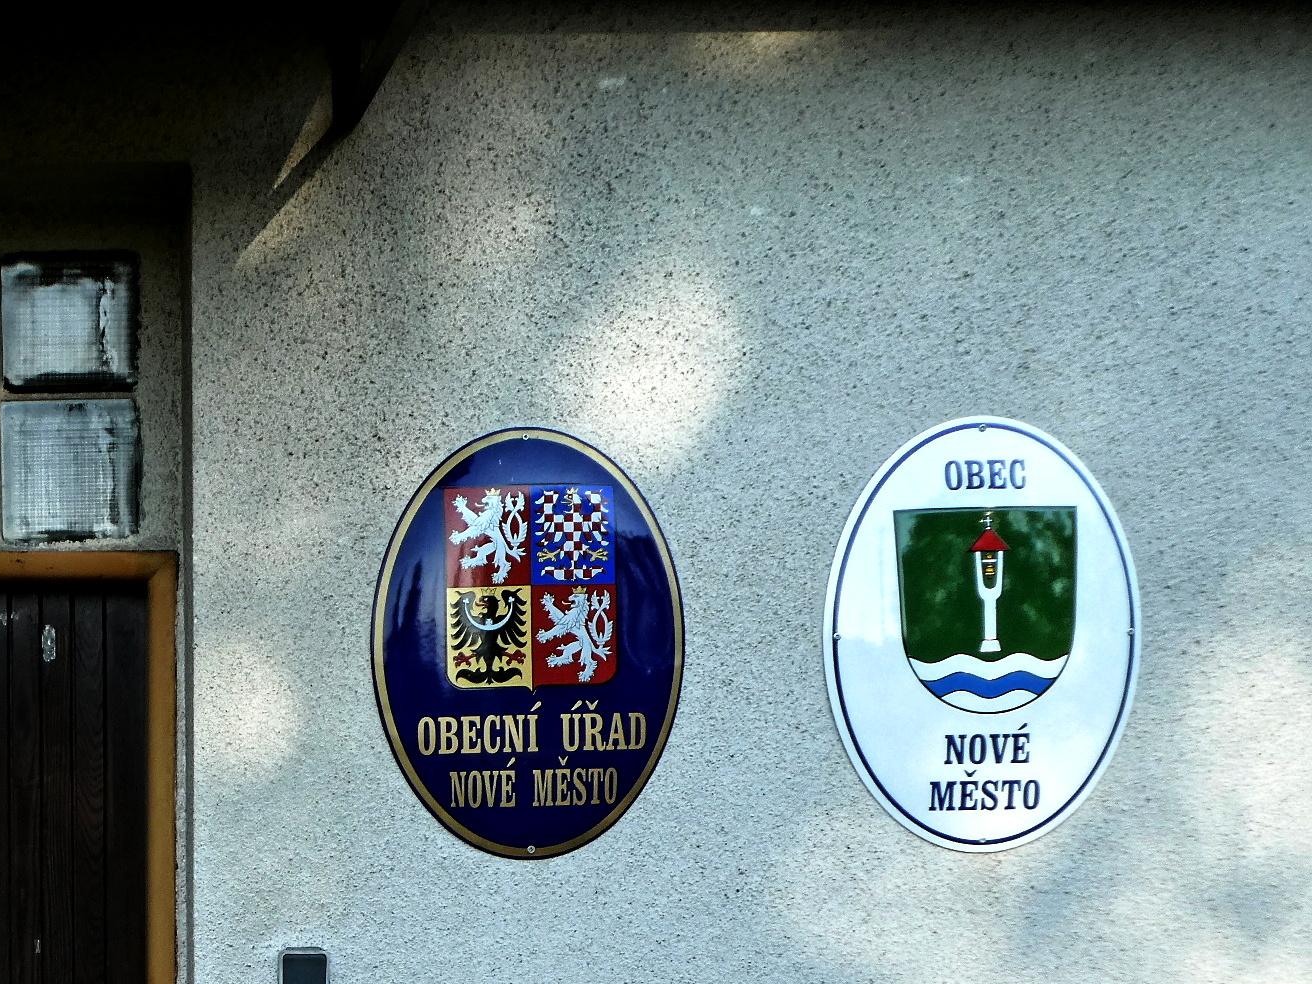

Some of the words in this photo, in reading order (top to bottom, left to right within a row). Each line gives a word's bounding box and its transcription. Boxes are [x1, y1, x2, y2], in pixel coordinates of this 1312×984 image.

[944, 459, 1027, 491] OBEC
[417, 701, 542, 756] OBECNÍ
[560, 699, 647, 752] ÚŘAD
[943, 723, 1031, 765] NOVÉ
[449, 758, 516, 809] NOVÉ
[532, 755, 618, 807] MĚSTO
[929, 769, 1041, 812] MĚSTO
